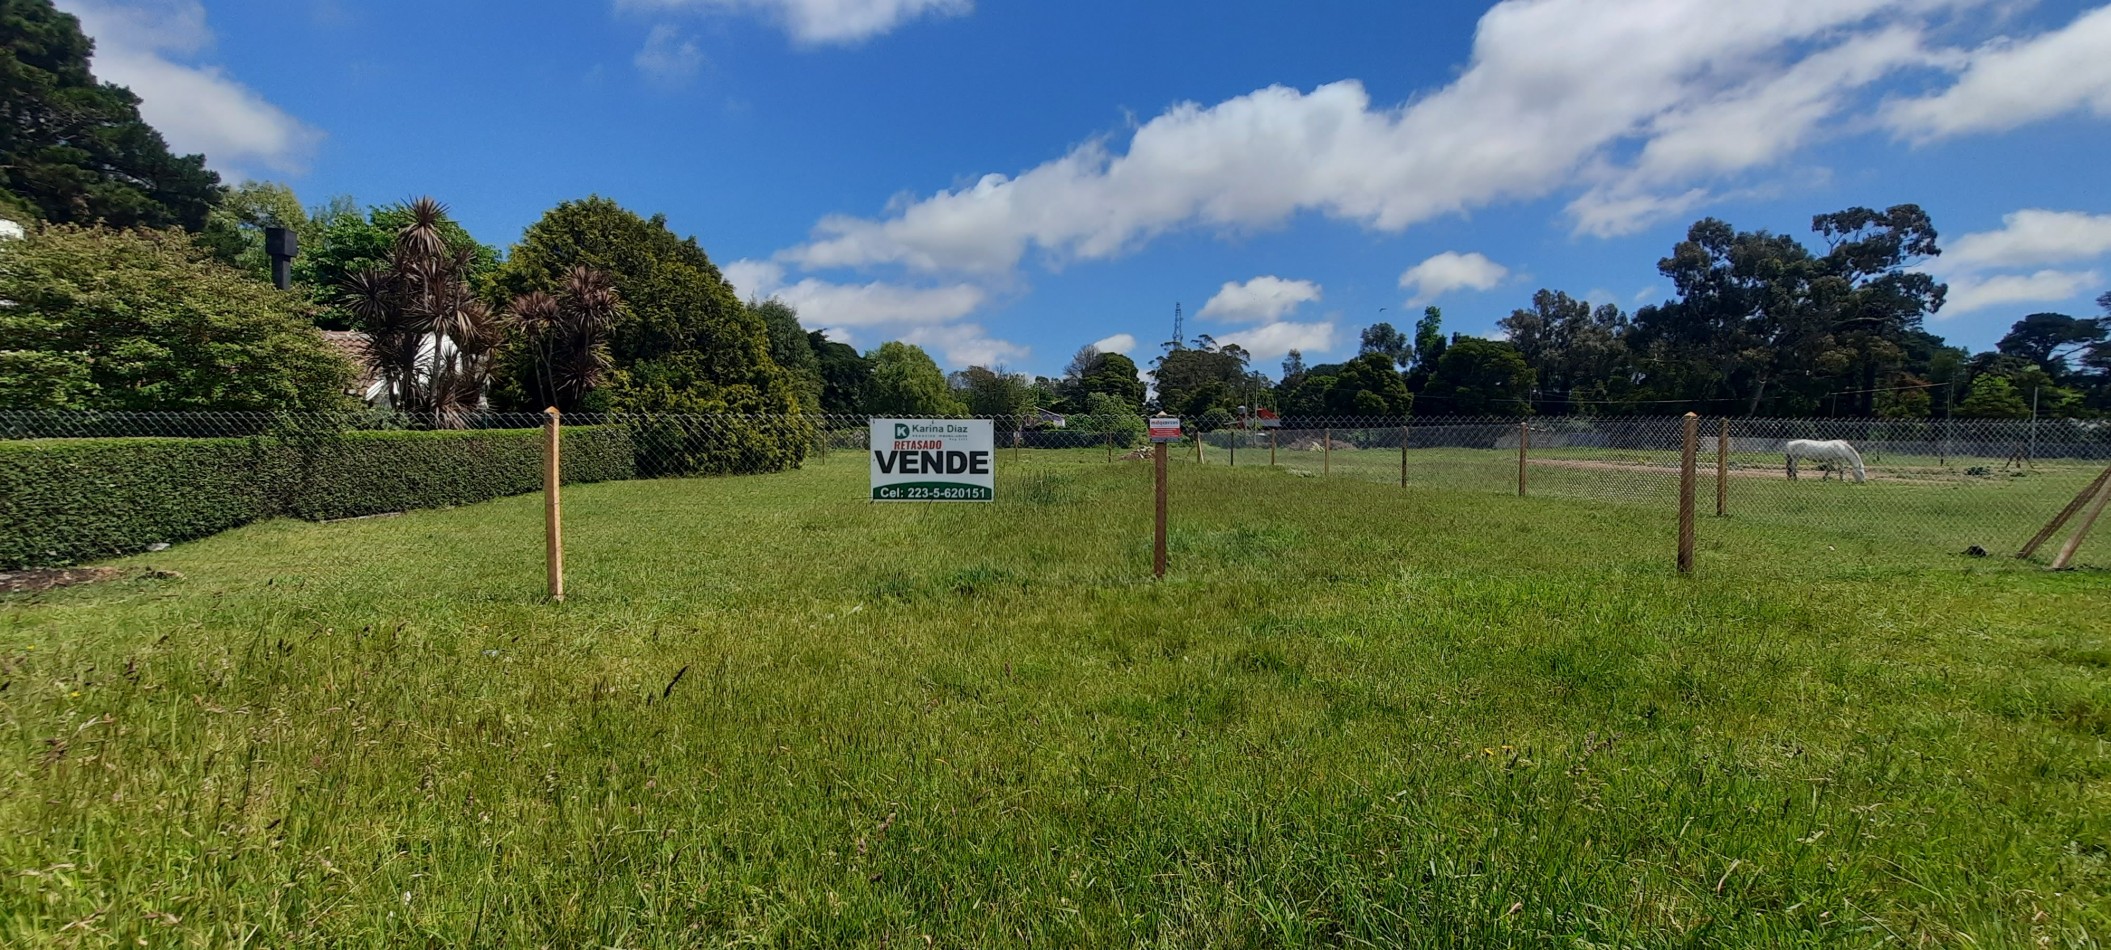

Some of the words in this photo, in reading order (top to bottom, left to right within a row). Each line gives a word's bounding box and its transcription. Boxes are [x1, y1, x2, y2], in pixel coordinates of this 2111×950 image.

[912, 425, 944, 433] Karina
[894, 440, 942, 450] RETASADO
[874, 450, 989, 474] VENDE
[880, 487, 904, 498] Cel:
[907, 487, 985, 499] 223-5-620151
